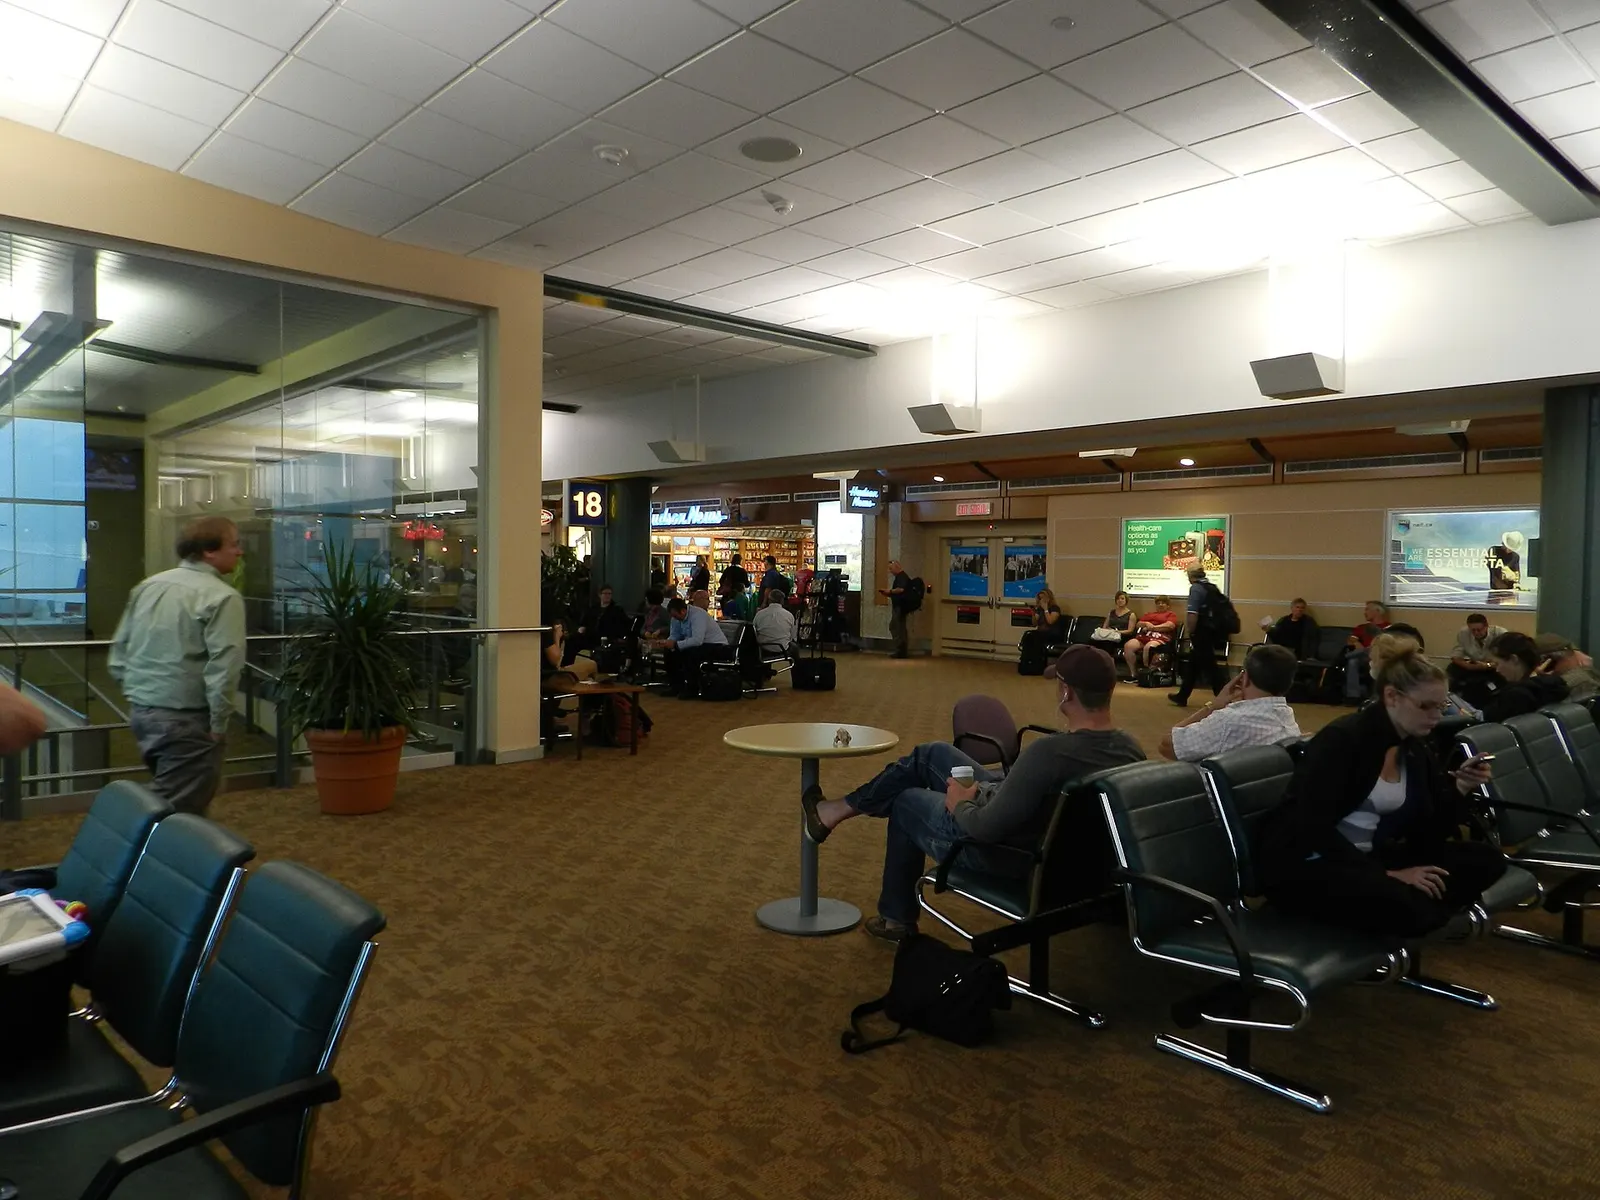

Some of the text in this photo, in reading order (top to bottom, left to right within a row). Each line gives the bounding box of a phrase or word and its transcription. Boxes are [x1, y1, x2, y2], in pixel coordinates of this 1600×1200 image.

[573, 491, 603, 518] 18
[651, 505, 728, 526] udson News
[1127, 532, 1150, 540] options
[1135, 547, 1147, 555] you
[1426, 547, 1498, 558] ESSENTIAL
[1428, 558, 1505, 569] TO ALBERTA
